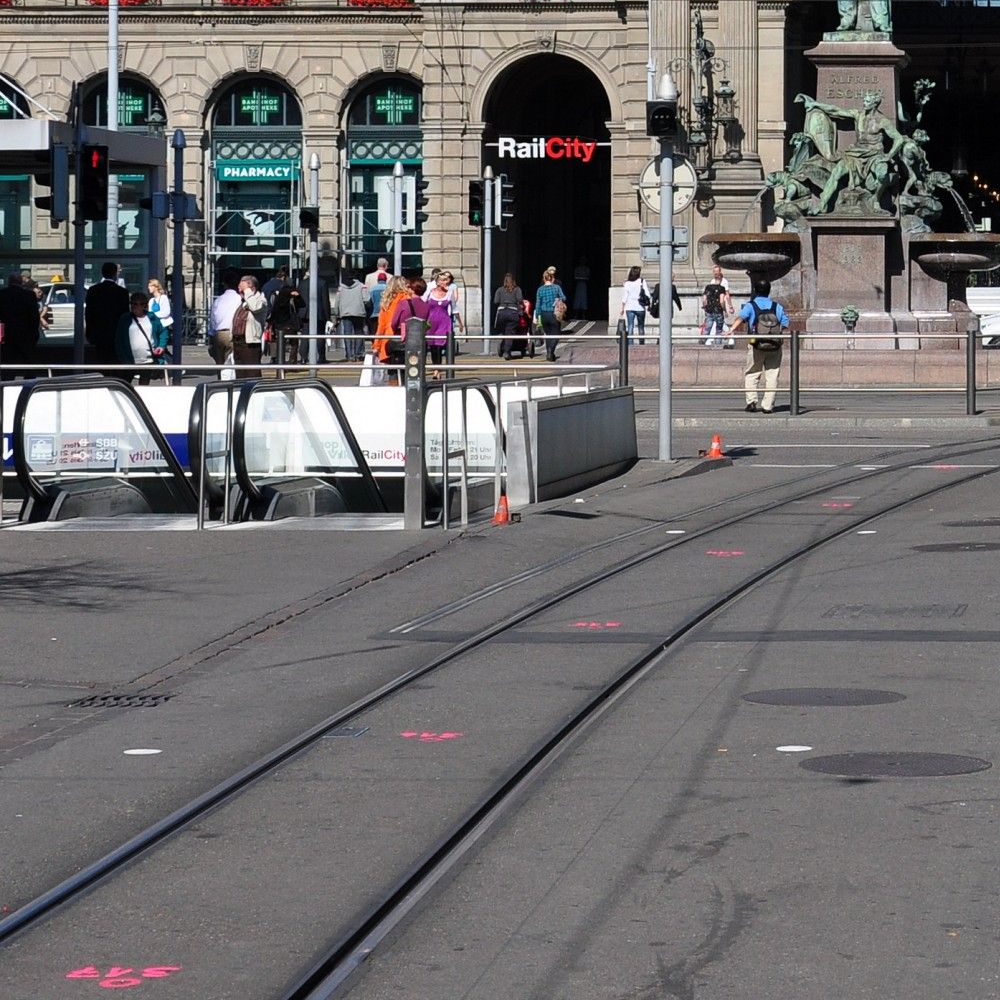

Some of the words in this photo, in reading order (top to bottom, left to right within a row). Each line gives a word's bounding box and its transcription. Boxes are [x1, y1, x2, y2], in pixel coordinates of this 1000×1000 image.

[831, 74, 879, 84] ALFRED
[498, 136, 596, 162] RailCity
[223, 167, 290, 177] PHARMACY
[96, 438, 118, 447] SBB
